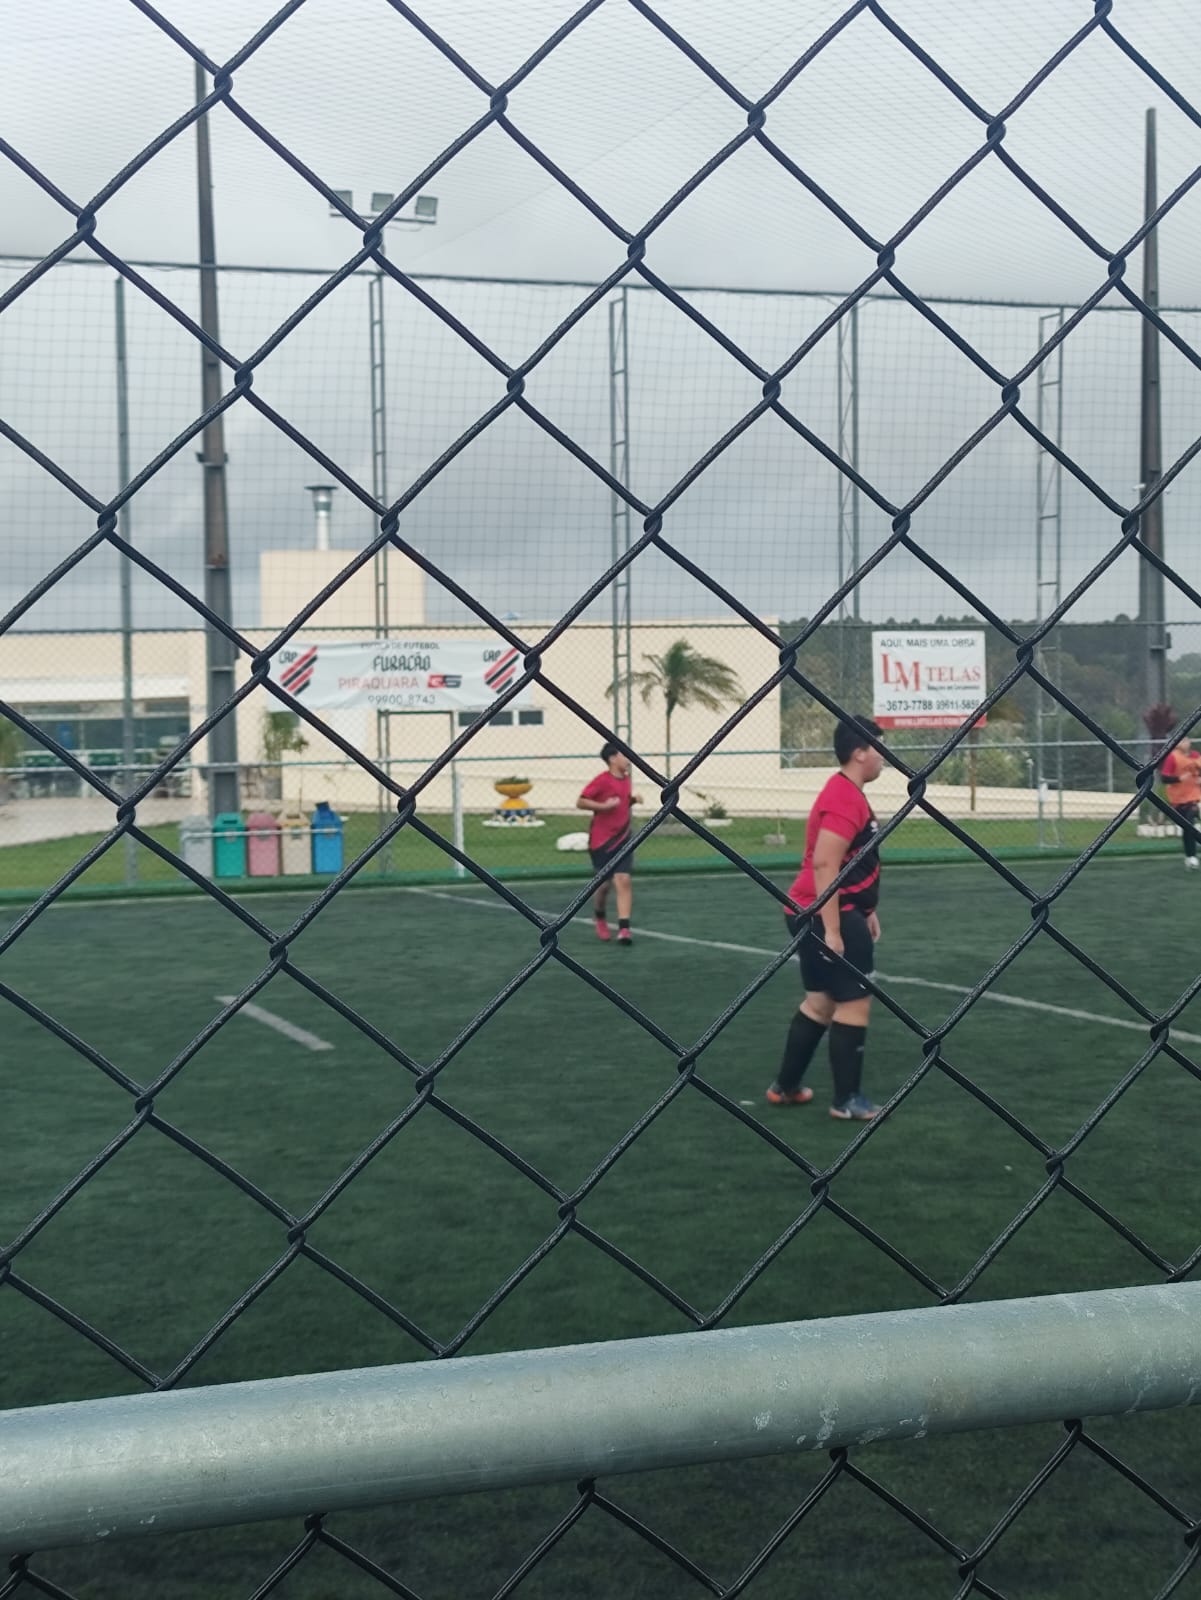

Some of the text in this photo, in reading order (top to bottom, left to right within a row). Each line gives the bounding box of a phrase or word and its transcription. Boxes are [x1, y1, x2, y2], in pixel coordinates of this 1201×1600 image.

[403, 642, 440, 650] FUTEBOL
[907, 638, 928, 647] MAIS
[930, 638, 949, 647] UMA
[951, 638, 975, 647] OBRA
[279, 651, 298, 664] CAP
[373, 652, 431, 672] FURACÃO
[483, 650, 502, 663] CAP
[881, 653, 921, 692] LM
[925, 666, 981, 682] TELAS
[338, 675, 419, 690] PIRAQUARA
[407, 694, 436, 705] 8743
[886, 700, 934, 711] 3673-7788
